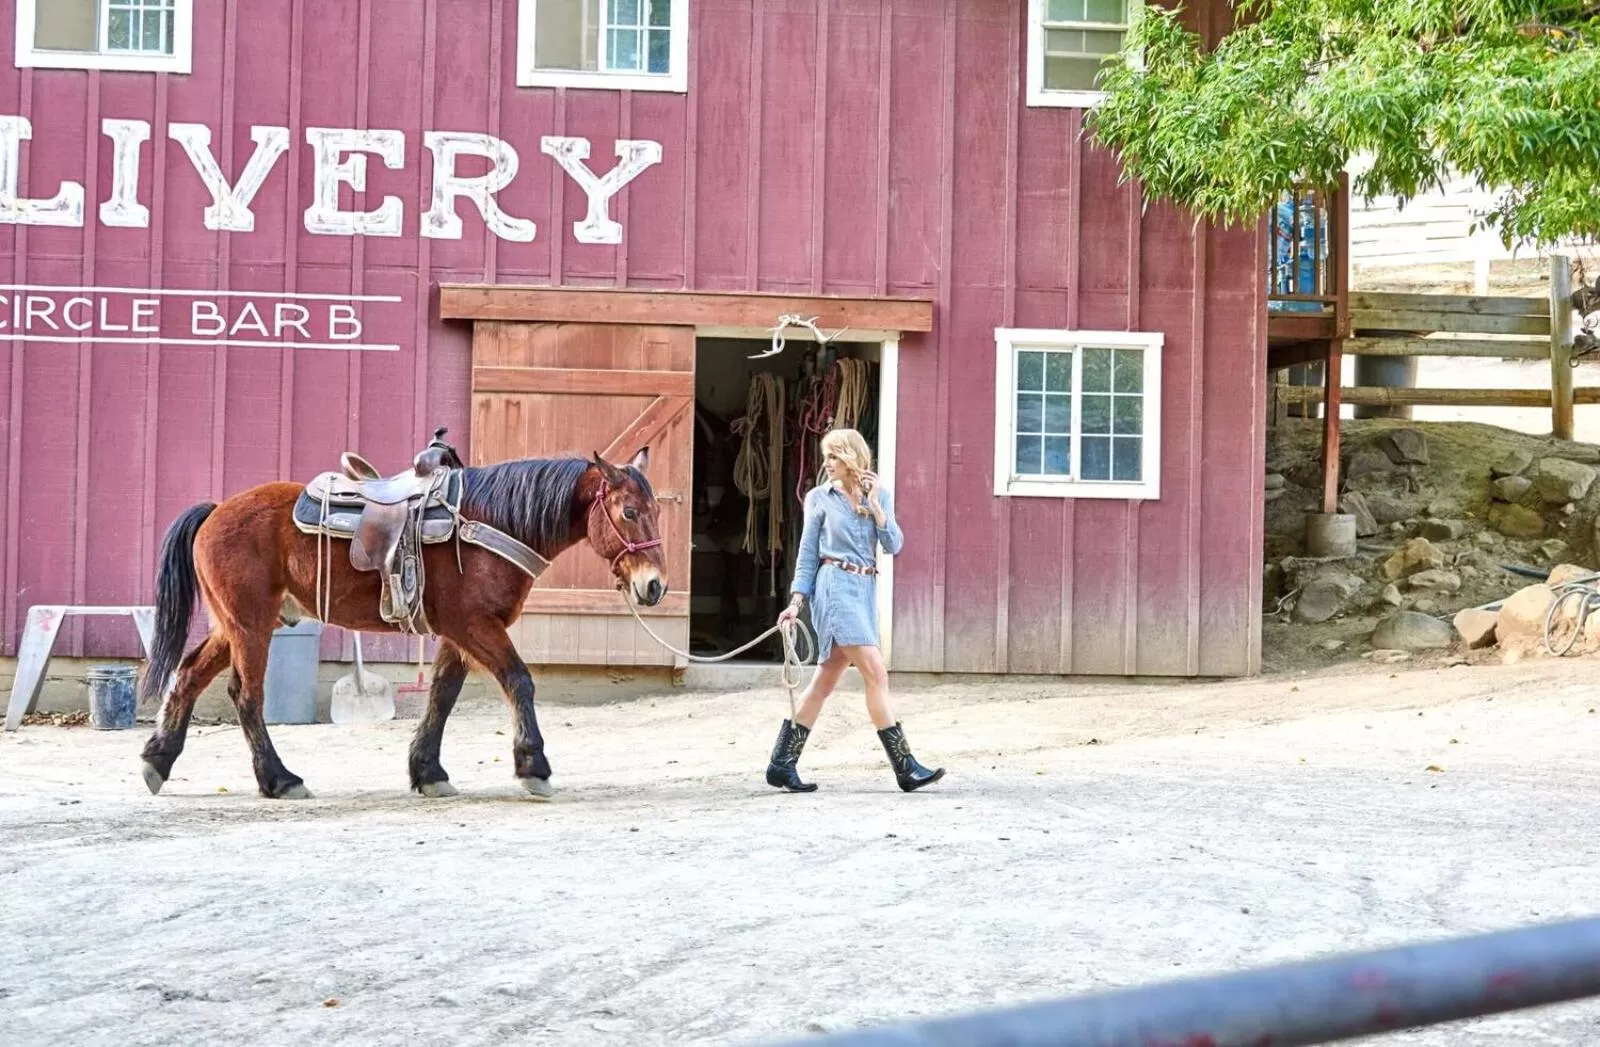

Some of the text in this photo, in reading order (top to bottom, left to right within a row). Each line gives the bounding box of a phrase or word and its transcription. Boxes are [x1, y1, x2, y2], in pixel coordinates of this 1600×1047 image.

[0, 115, 662, 245] LIVERY
[0, 294, 362, 340] IRCLE BAR B
